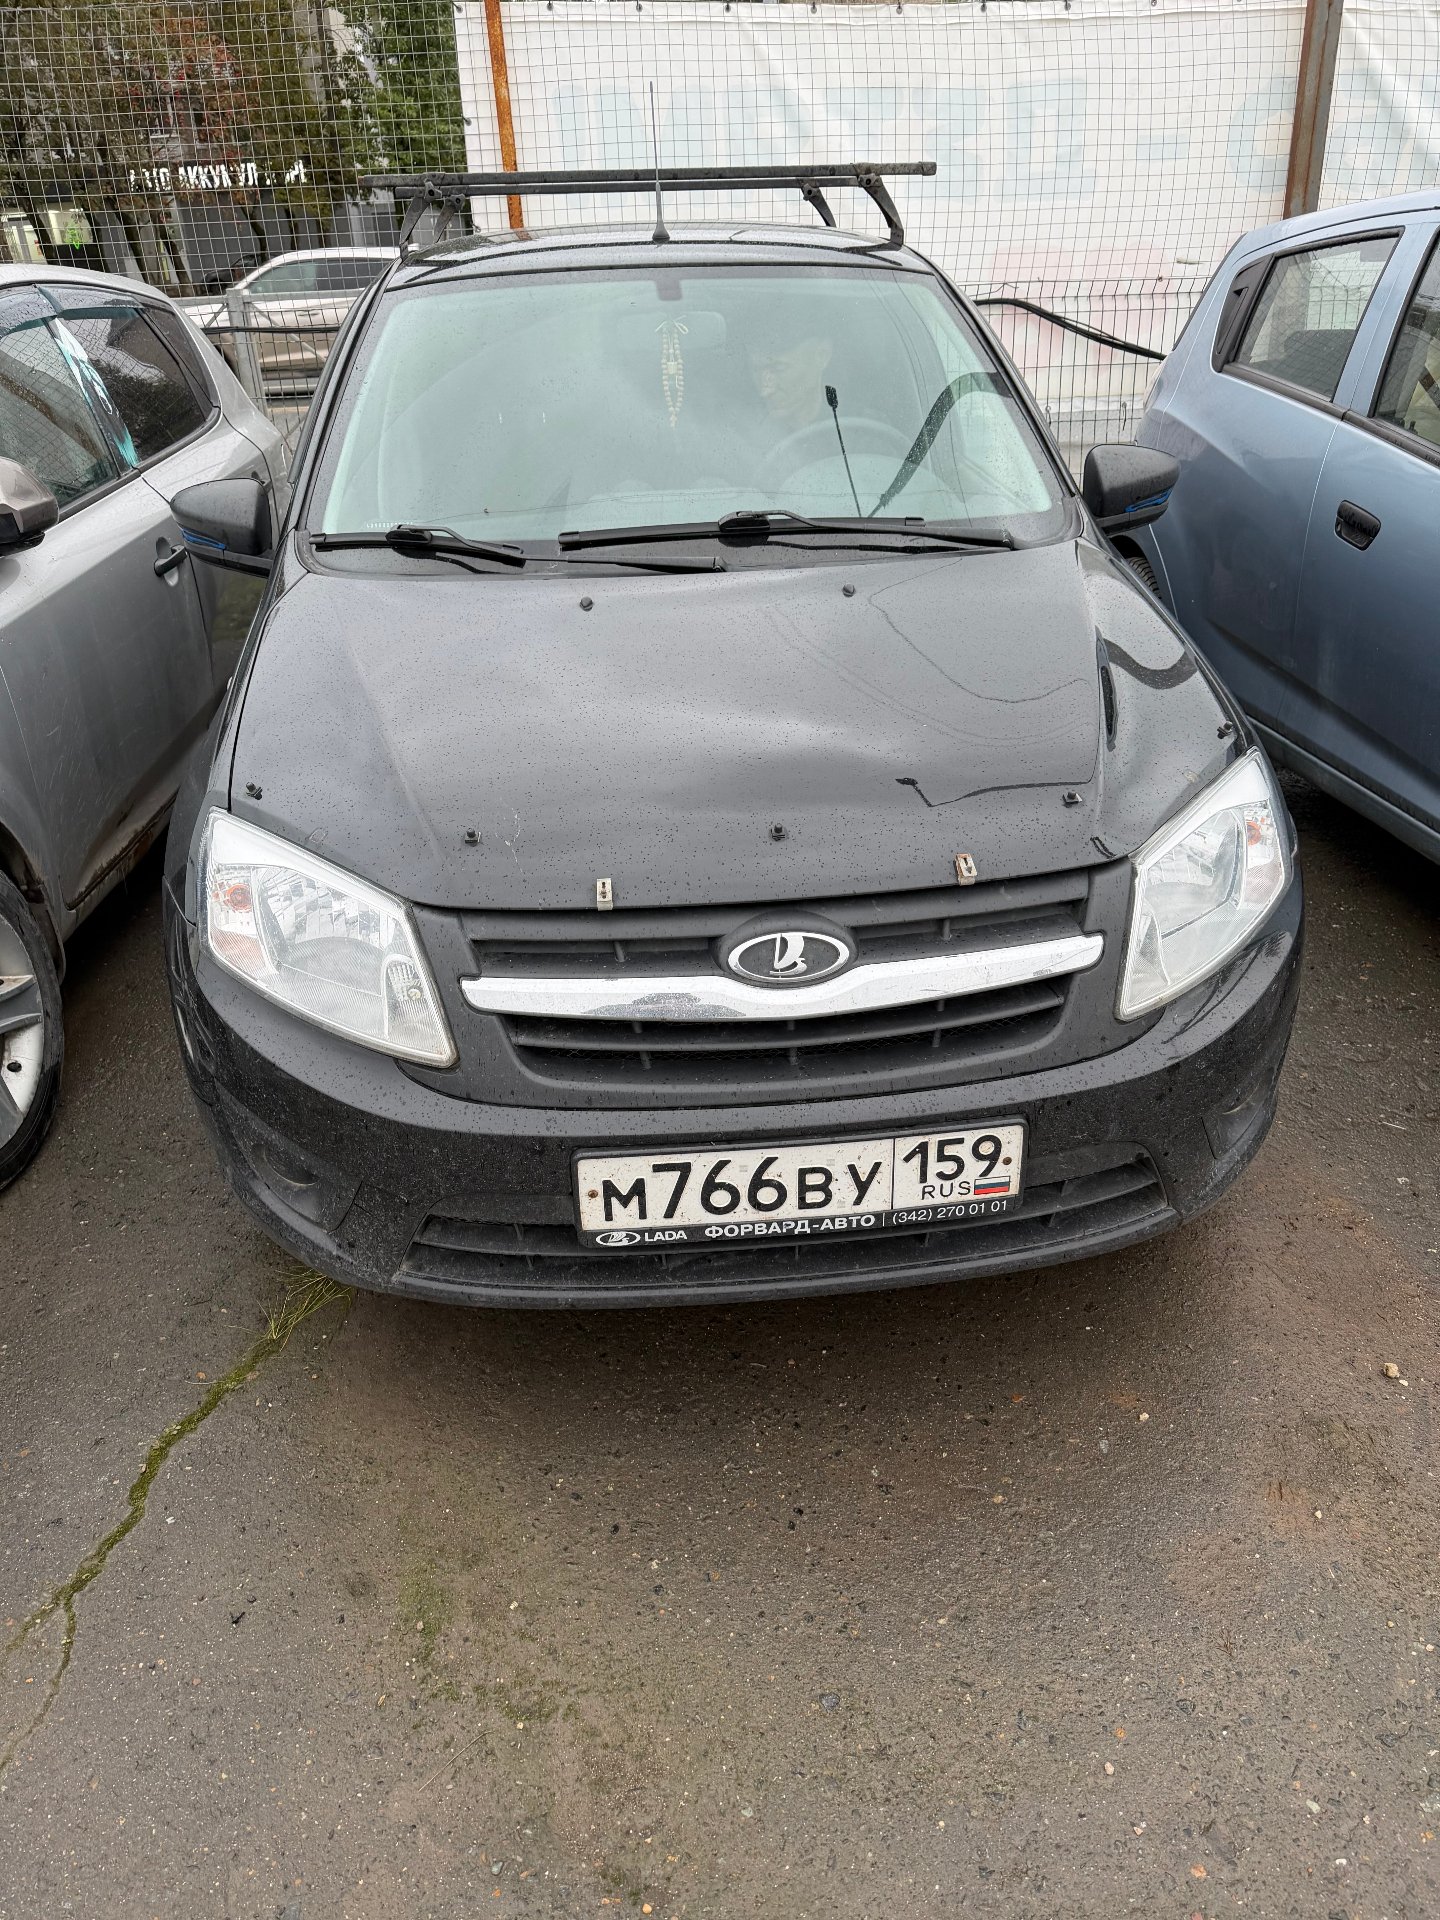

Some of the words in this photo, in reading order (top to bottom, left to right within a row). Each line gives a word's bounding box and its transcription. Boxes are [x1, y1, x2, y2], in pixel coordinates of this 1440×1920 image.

[902, 1134, 1004, 1184] 159
[921, 1180, 971, 1200] RUS
[644, 1229, 688, 1242] LADA
[704, 1214, 876, 1239] ФОРВАРД-АВТО
[892, 1208, 933, 1226] (342)
[936, 1204, 966, 1219] 270
[968, 1202, 986, 1216] 01
[990, 1200, 1008, 1213] 01
